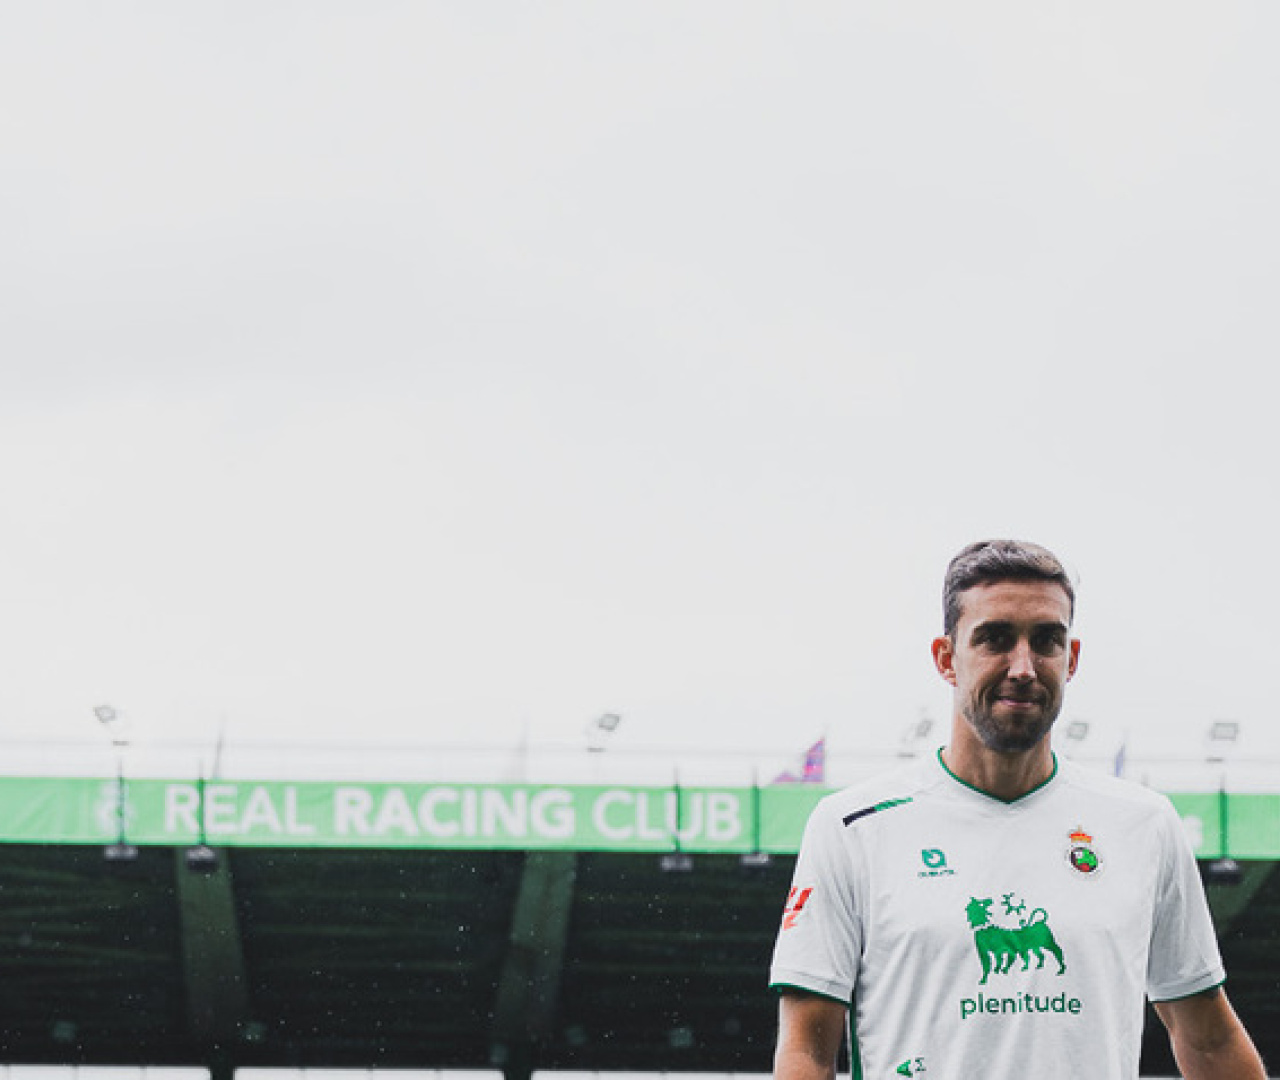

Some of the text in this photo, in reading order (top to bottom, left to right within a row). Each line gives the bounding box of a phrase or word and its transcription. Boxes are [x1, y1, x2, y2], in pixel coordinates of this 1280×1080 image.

[163, 783, 743, 841] REAL RACING CLUB
[960, 991, 1082, 1020] plenitude
